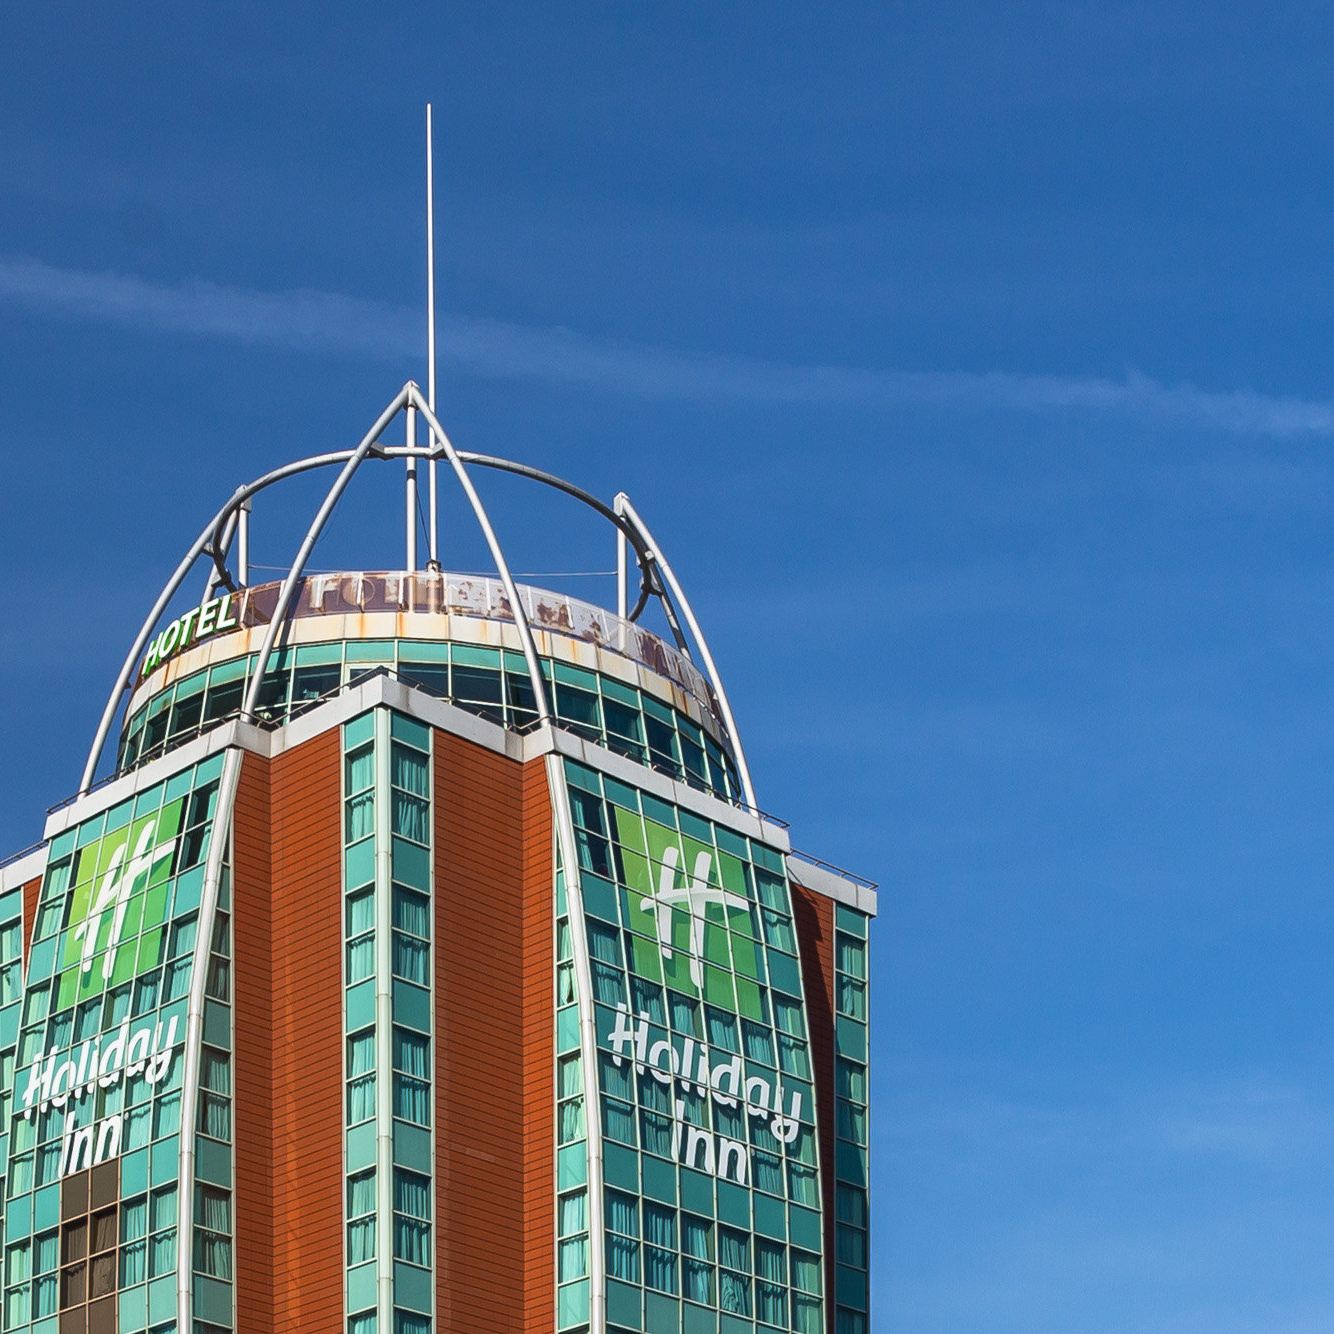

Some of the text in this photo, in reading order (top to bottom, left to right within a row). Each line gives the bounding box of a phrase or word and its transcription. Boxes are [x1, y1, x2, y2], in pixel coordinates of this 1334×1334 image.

[142, 594, 237, 676] HOTEL
[22, 1015, 179, 1120] Holiday
[608, 1002, 802, 1144] Holiday
[58, 1111, 122, 1178] Inn
[671, 1099, 748, 1185] Inn
